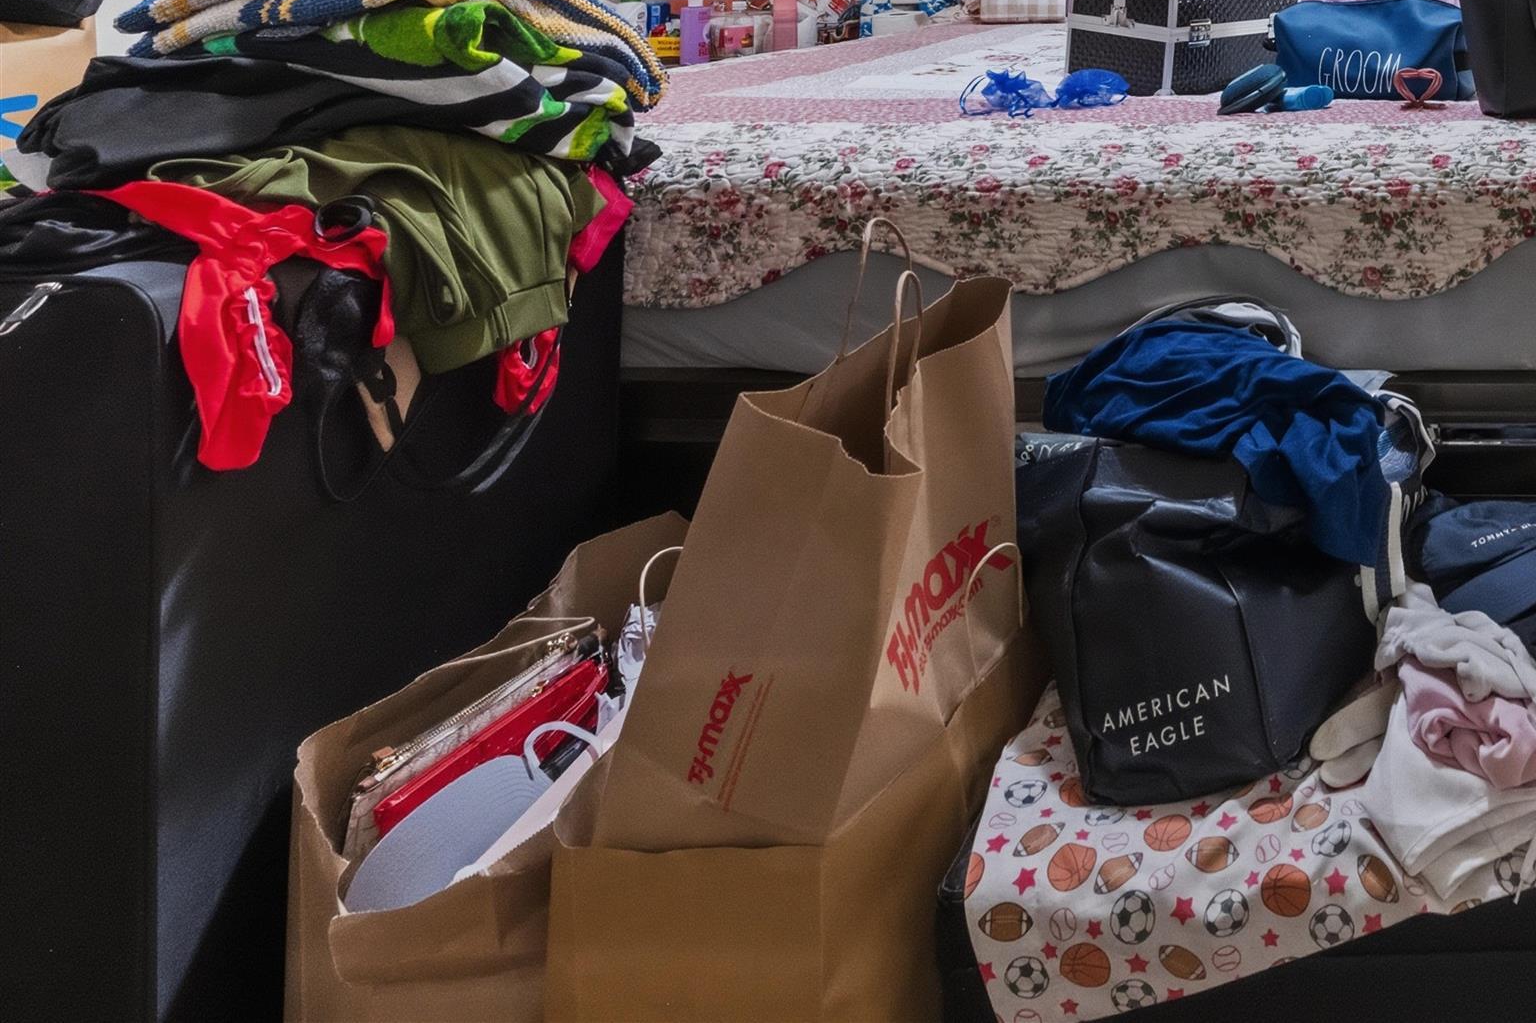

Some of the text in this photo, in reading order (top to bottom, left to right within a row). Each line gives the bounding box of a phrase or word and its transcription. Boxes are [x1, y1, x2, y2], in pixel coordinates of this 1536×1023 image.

[1318, 47, 1402, 94] GROOM
[1102, 674, 1231, 733] AMERICAN
[1130, 715, 1206, 757] EAGLE
